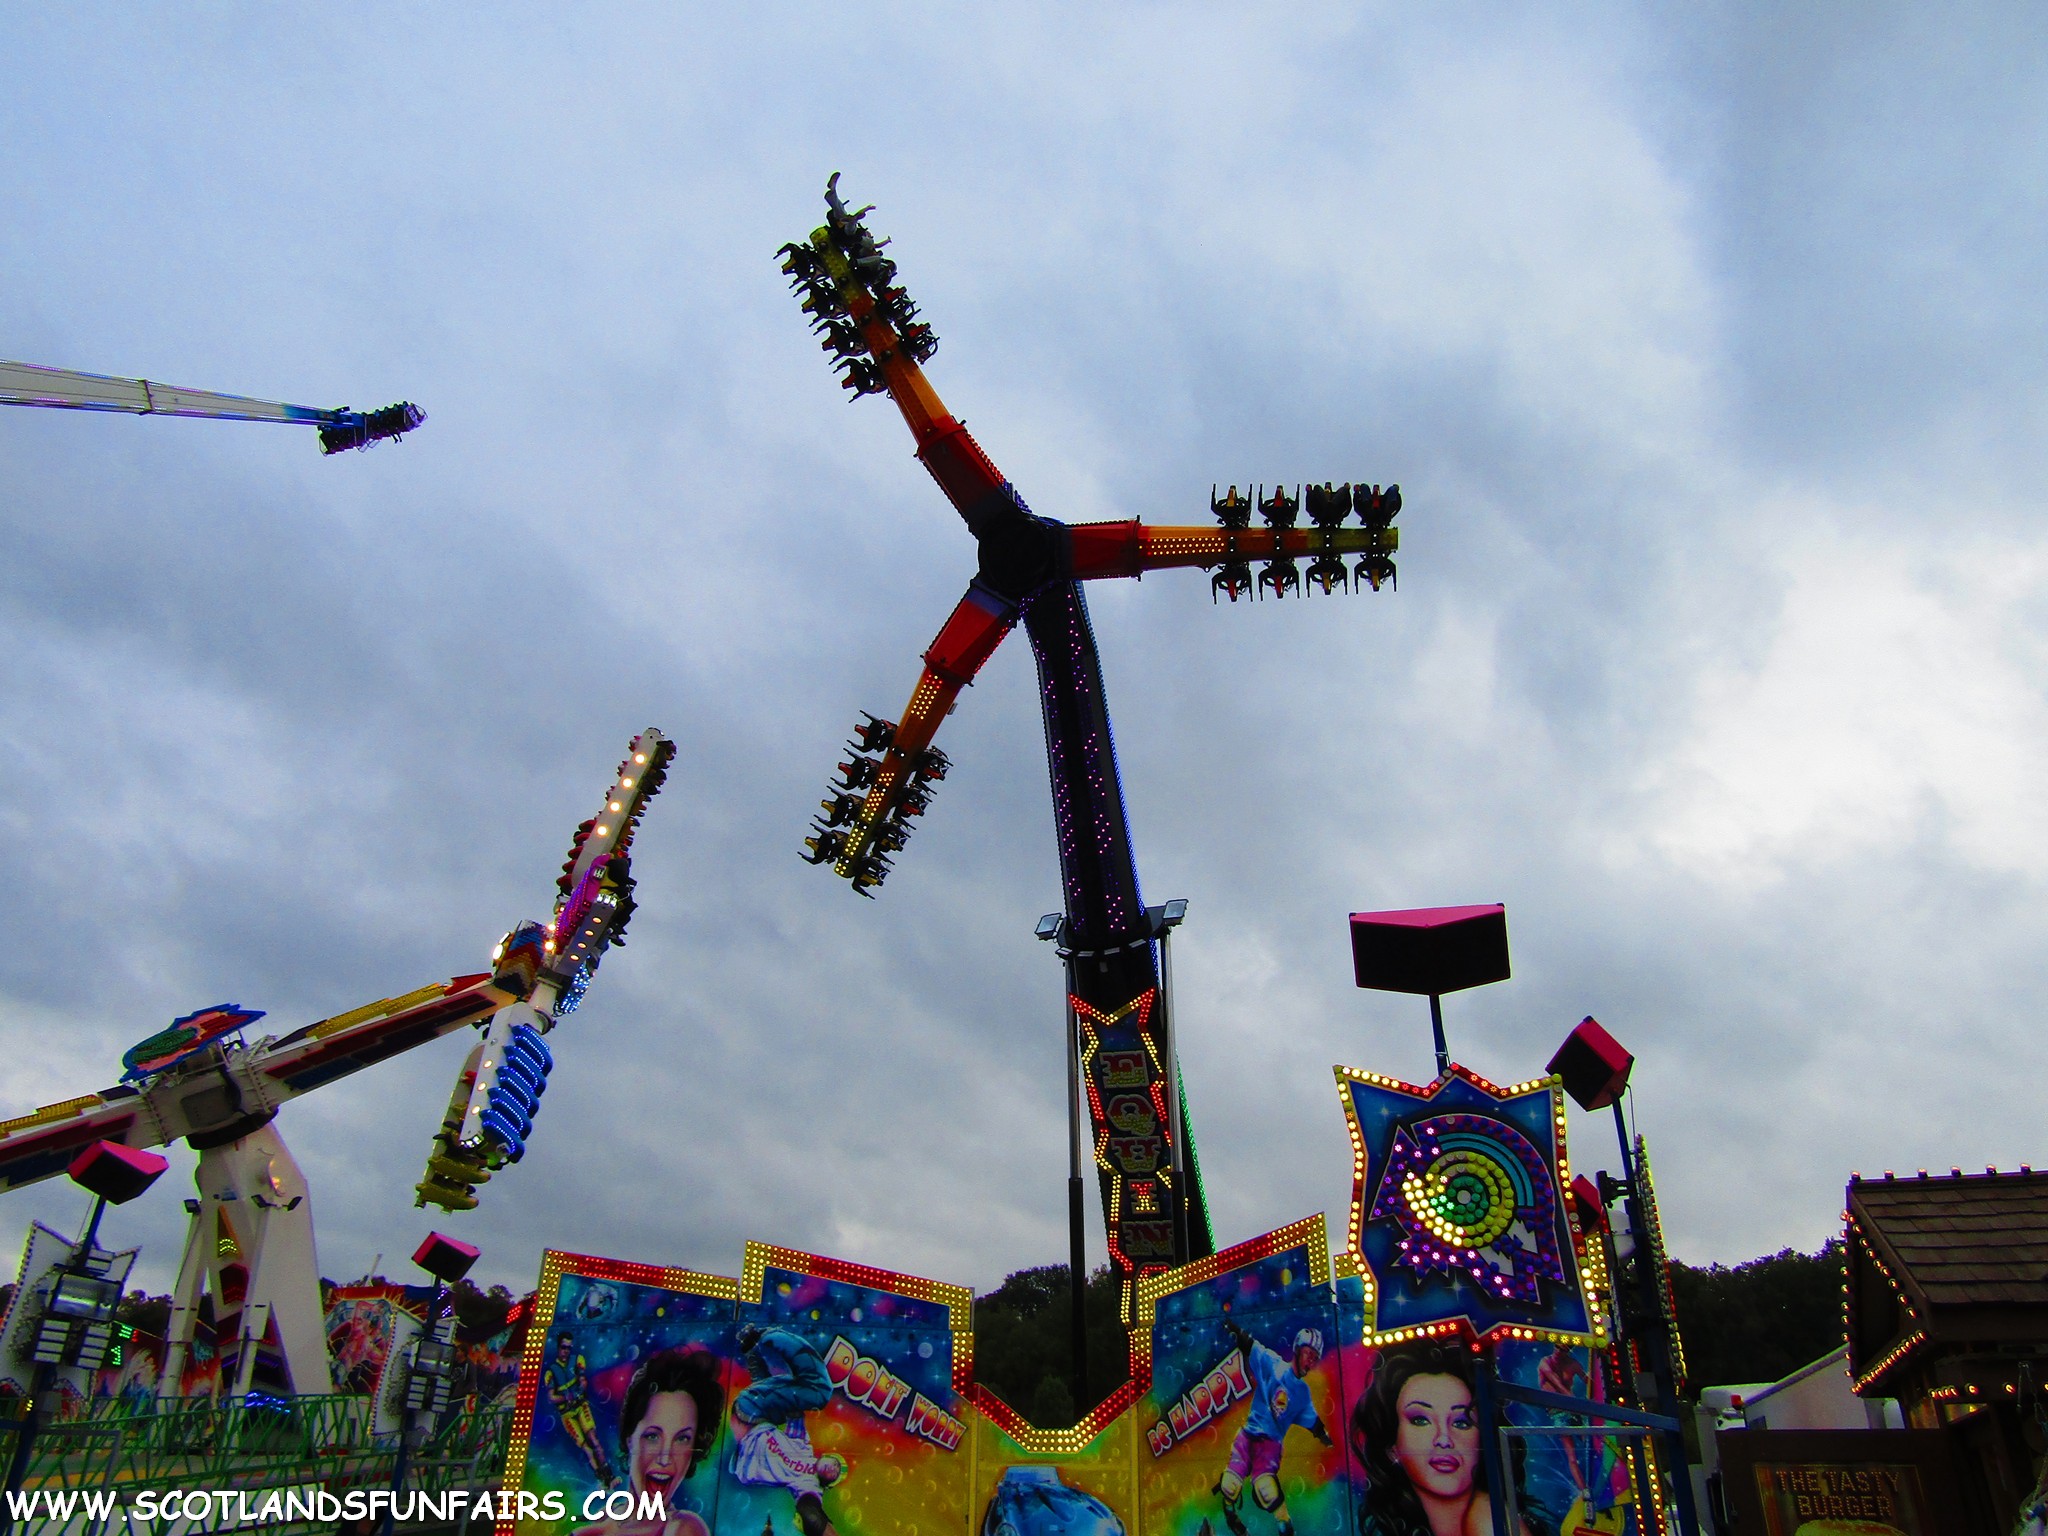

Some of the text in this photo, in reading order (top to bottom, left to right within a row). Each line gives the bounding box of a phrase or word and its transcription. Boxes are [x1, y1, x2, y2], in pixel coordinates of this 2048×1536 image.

[1167, 1347, 1252, 1441] HAPPY
[905, 1392, 967, 1450] WORRY
[1775, 1470, 1900, 1493] THE TASTY
[1797, 1495, 1892, 1517] BURGER
